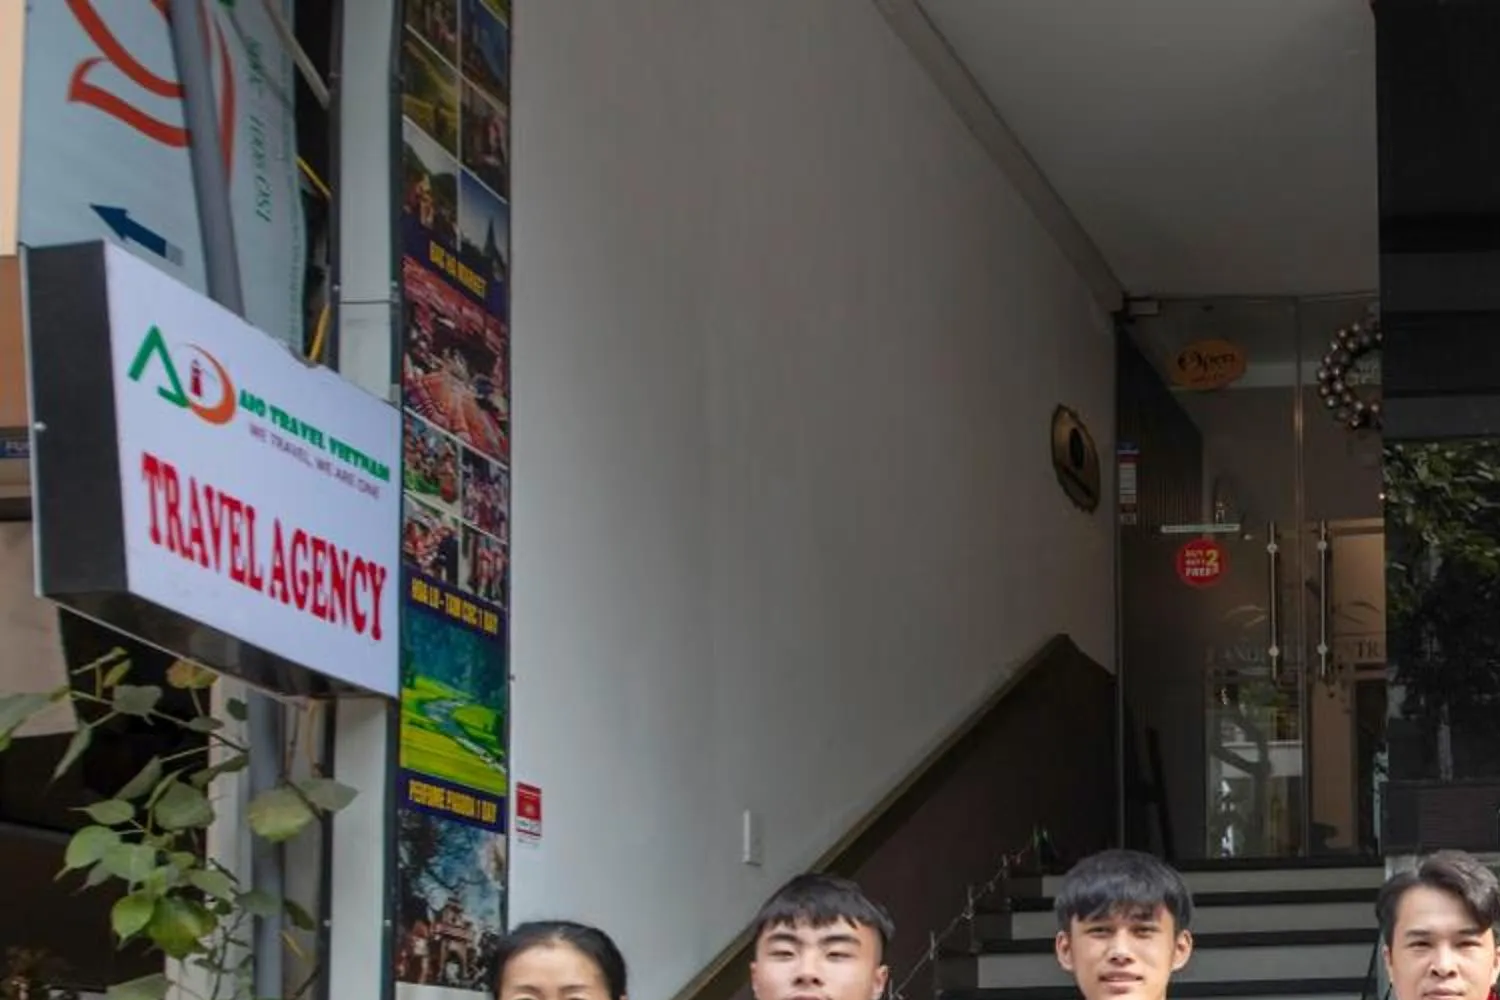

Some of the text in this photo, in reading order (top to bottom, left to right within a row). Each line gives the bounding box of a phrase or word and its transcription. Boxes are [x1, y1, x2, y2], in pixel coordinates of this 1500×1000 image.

[269, 404, 326, 449] TRAVEL
[329, 436, 390, 482] VIETNAM
[141, 451, 387, 641] TRAVEL AGENCY
